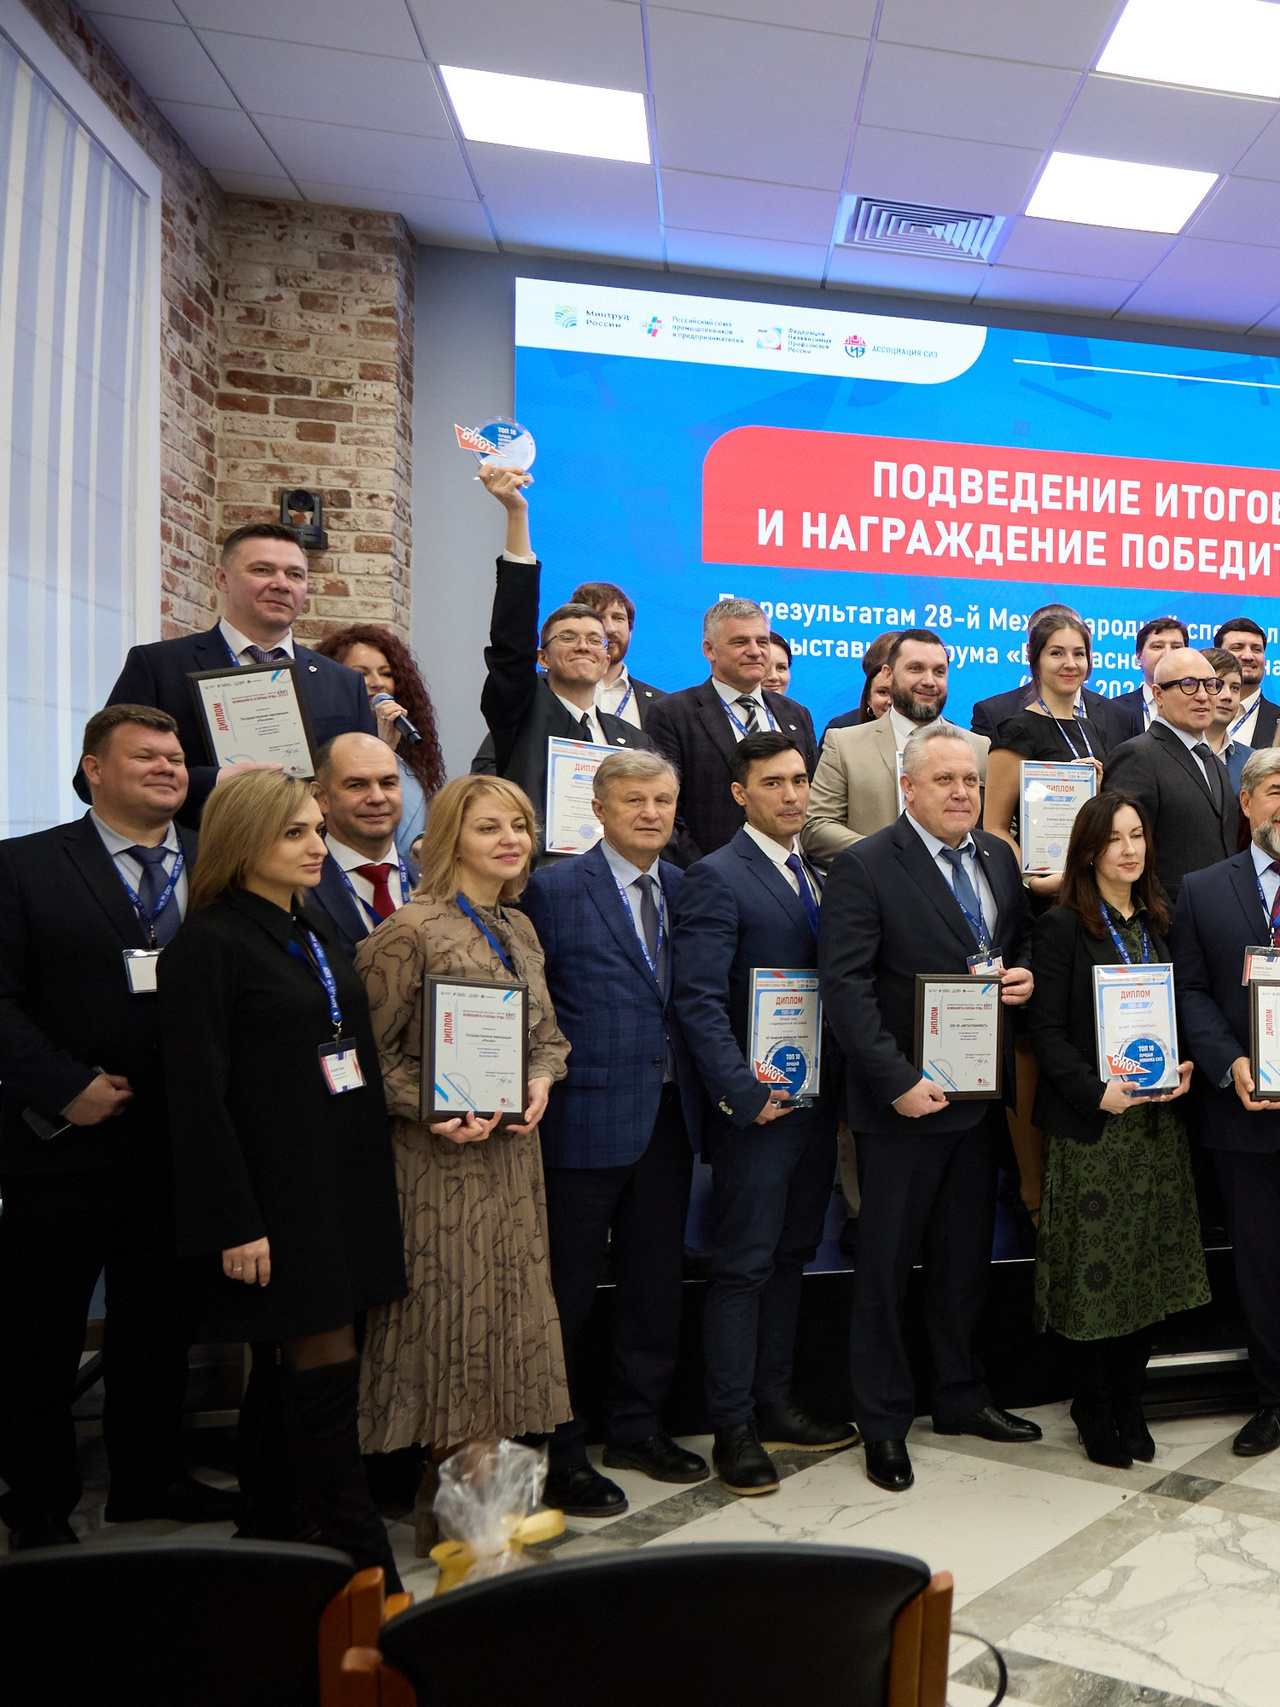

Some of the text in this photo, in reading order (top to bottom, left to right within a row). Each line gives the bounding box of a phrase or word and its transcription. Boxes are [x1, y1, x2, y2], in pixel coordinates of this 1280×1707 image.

[586, 310, 630, 321] Минтруд
[672, 315, 713, 326] Российский
[586, 320, 621, 328] России
[672, 325, 733, 335] промышленников
[678, 333, 744, 344] предпринимателей
[872, 345, 922, 357] АССОЦИАЦИЯ
[873, 460, 1141, 516] ПОДВЕДЕНИЕ
[757, 509, 785, 547] И
[801, 512, 1108, 568] НАГРАЖДЕНИЕ
[761, 600, 916, 627] результатам
[924, 603, 980, 630] 28-й
[213, 702, 229, 732] ДИПЛОМ
[575, 763, 597, 773] ДИПЛ
[776, 996, 803, 1005] ДИПЛОМ
[1121, 990, 1151, 1000] ДИПЛОМ
[444, 1012, 453, 1044] ДИПЛОМ
[1266, 1009, 1274, 1036] ДИПЛОМ
[1112, 1053, 1140, 1073] БИОТ
[759, 1058, 784, 1083] БИОТ
